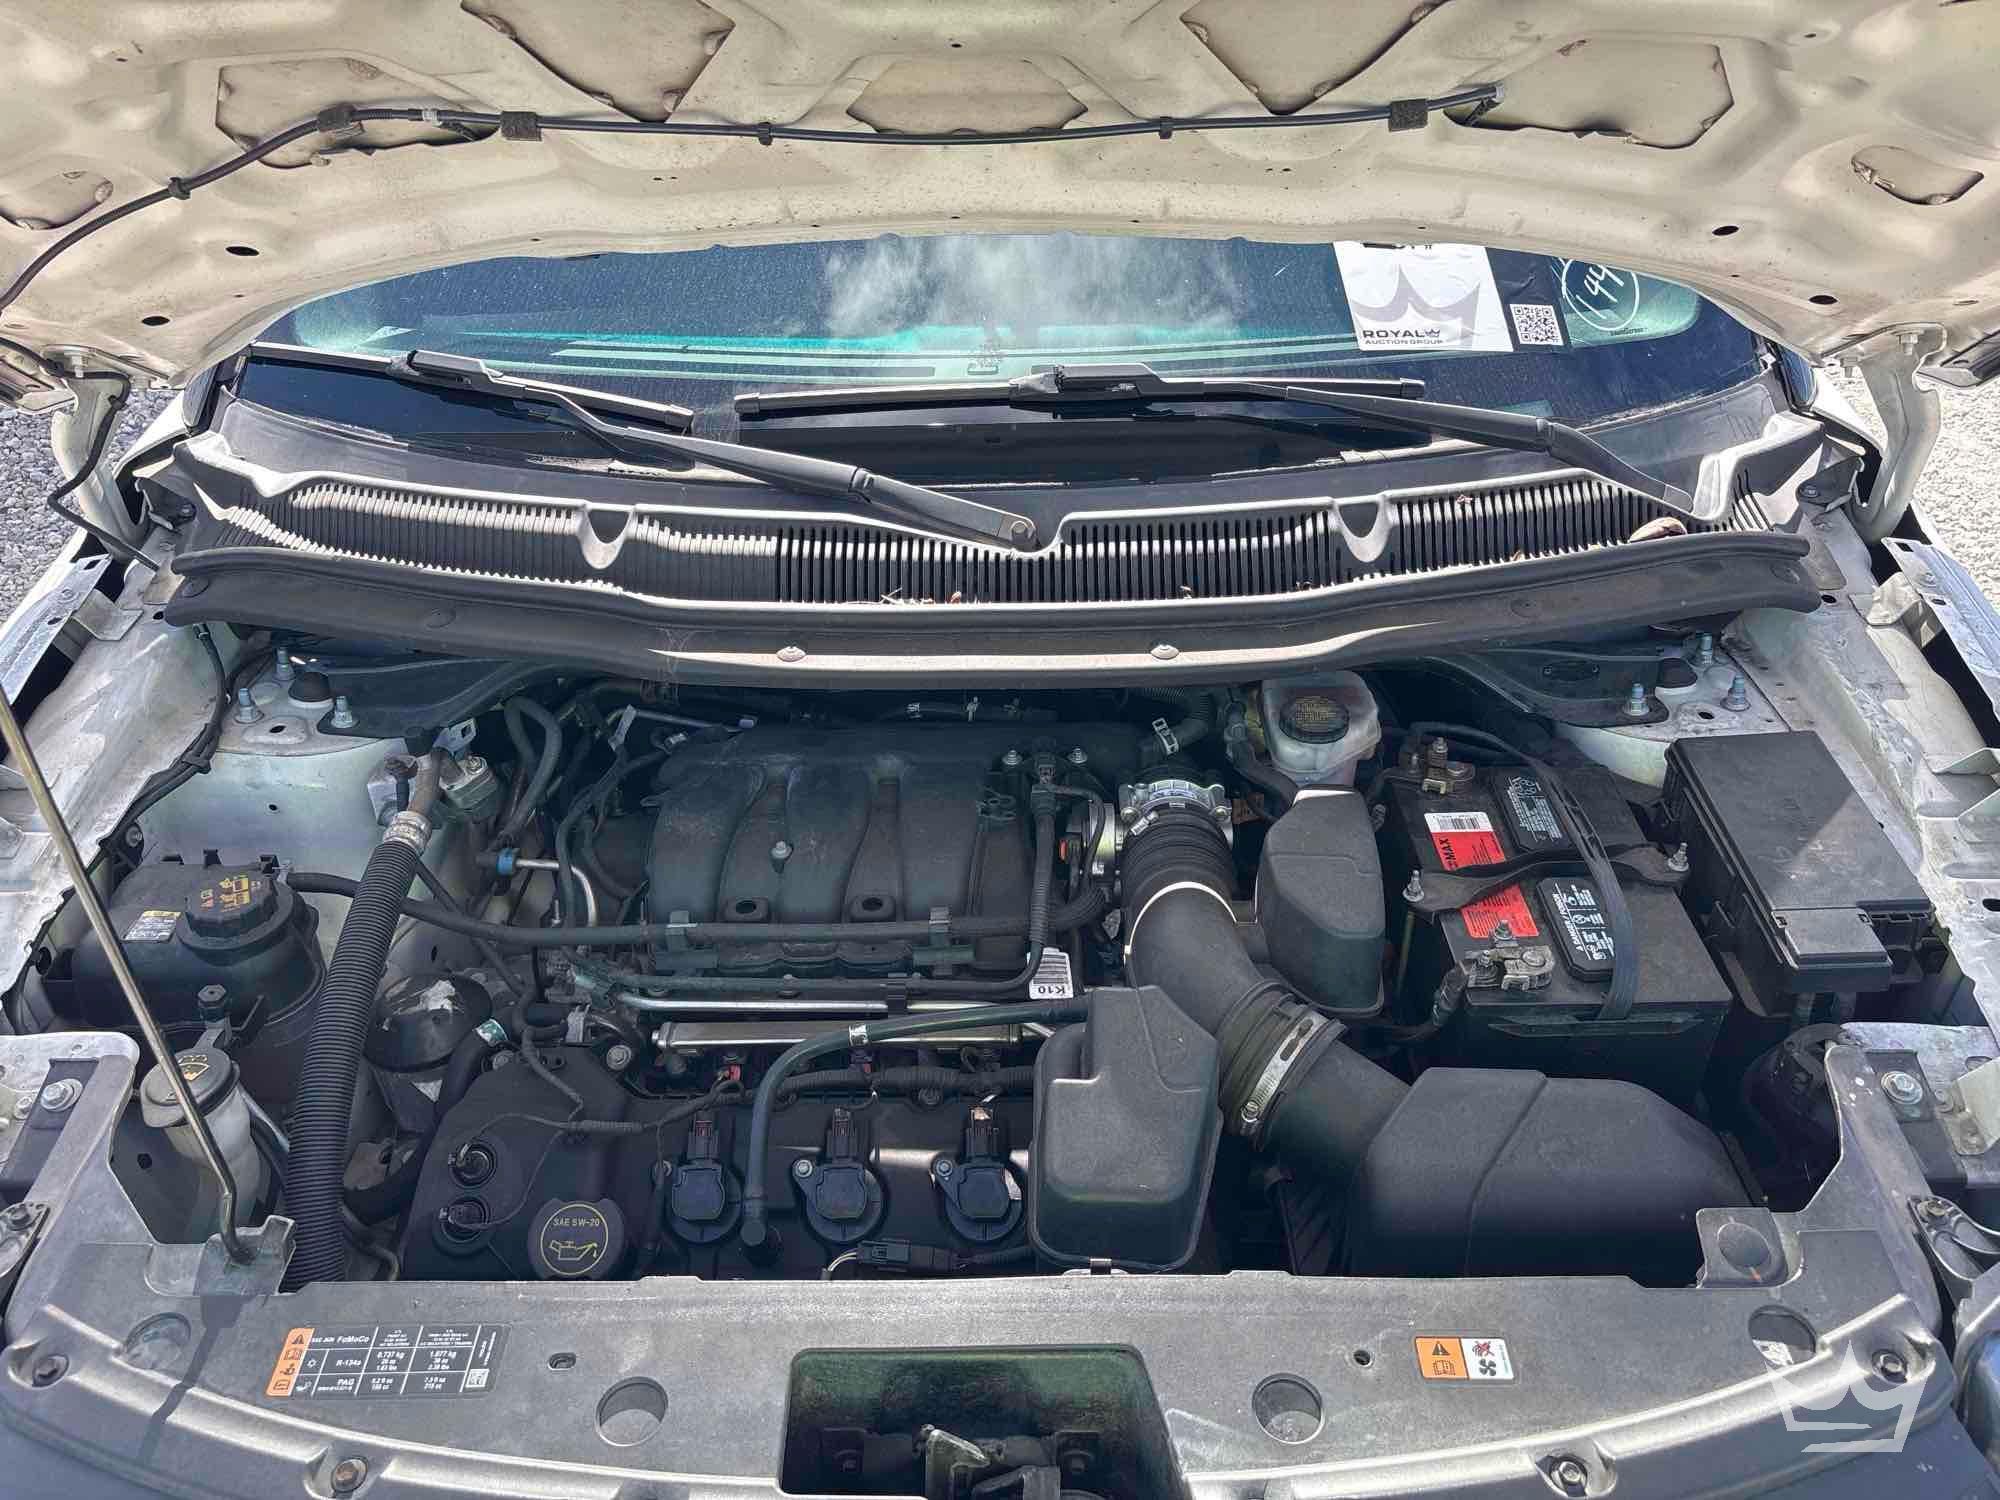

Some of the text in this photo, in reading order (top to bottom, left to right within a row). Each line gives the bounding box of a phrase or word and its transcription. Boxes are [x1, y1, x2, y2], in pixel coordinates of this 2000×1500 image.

[1362, 329, 1425, 338] ROYAL
[1038, 985, 1065, 994] K10
[553, 1217, 600, 1227] SAE 5W-20
